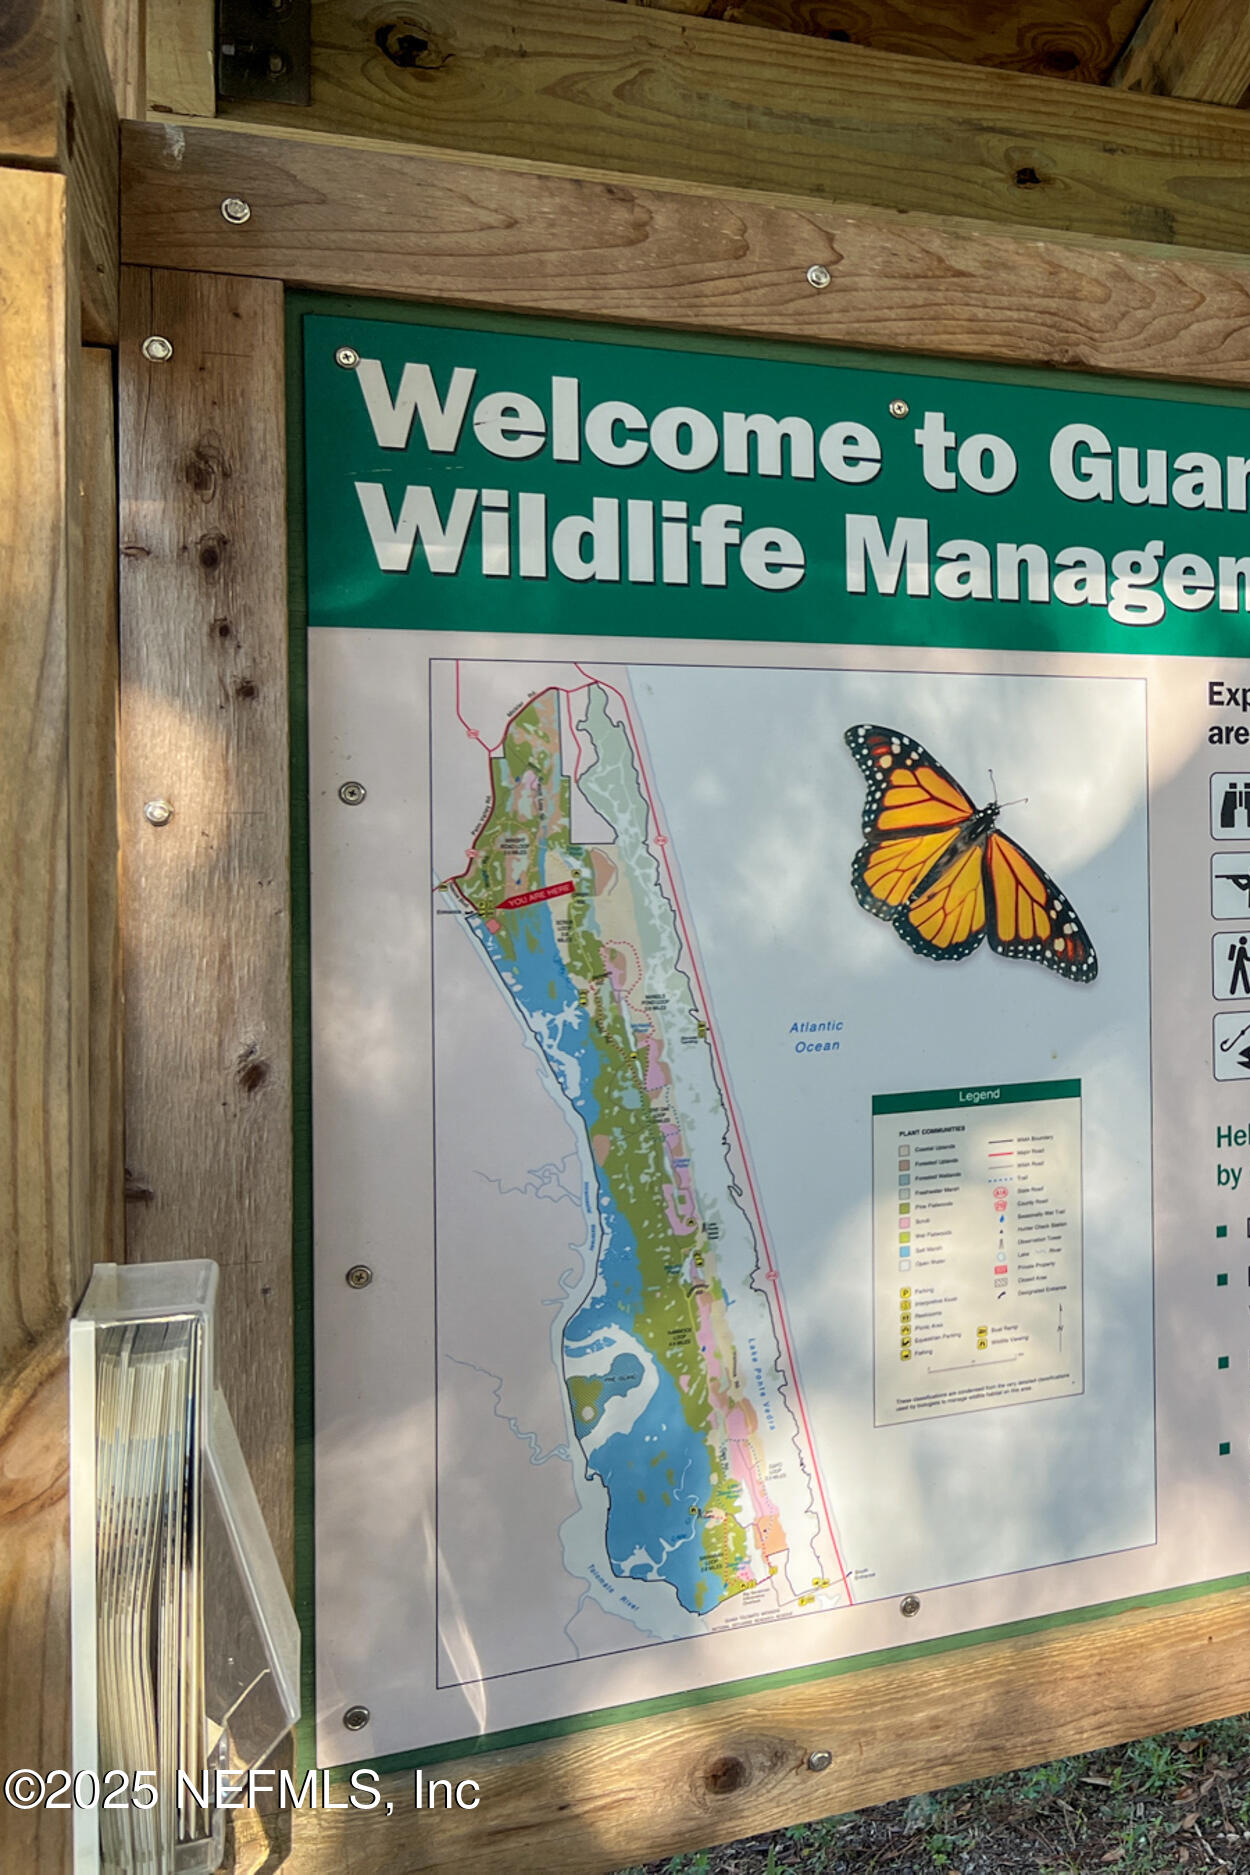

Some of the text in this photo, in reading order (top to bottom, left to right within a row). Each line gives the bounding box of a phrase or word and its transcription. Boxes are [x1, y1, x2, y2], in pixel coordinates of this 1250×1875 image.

[355, 358, 882, 483] Welcome
[915, 412, 1016, 492] to
[355, 482, 804, 589] Wildlife
[508, 896, 526, 907] YOU
[529, 890, 546, 902] ARE
[548, 884, 571, 898] HERE
[788, 1021, 844, 1034] Atlantic
[795, 1040, 840, 1053] Ocean
[959, 1088, 1000, 1104] Legend
[1218, 1164, 1242, 1190] by
